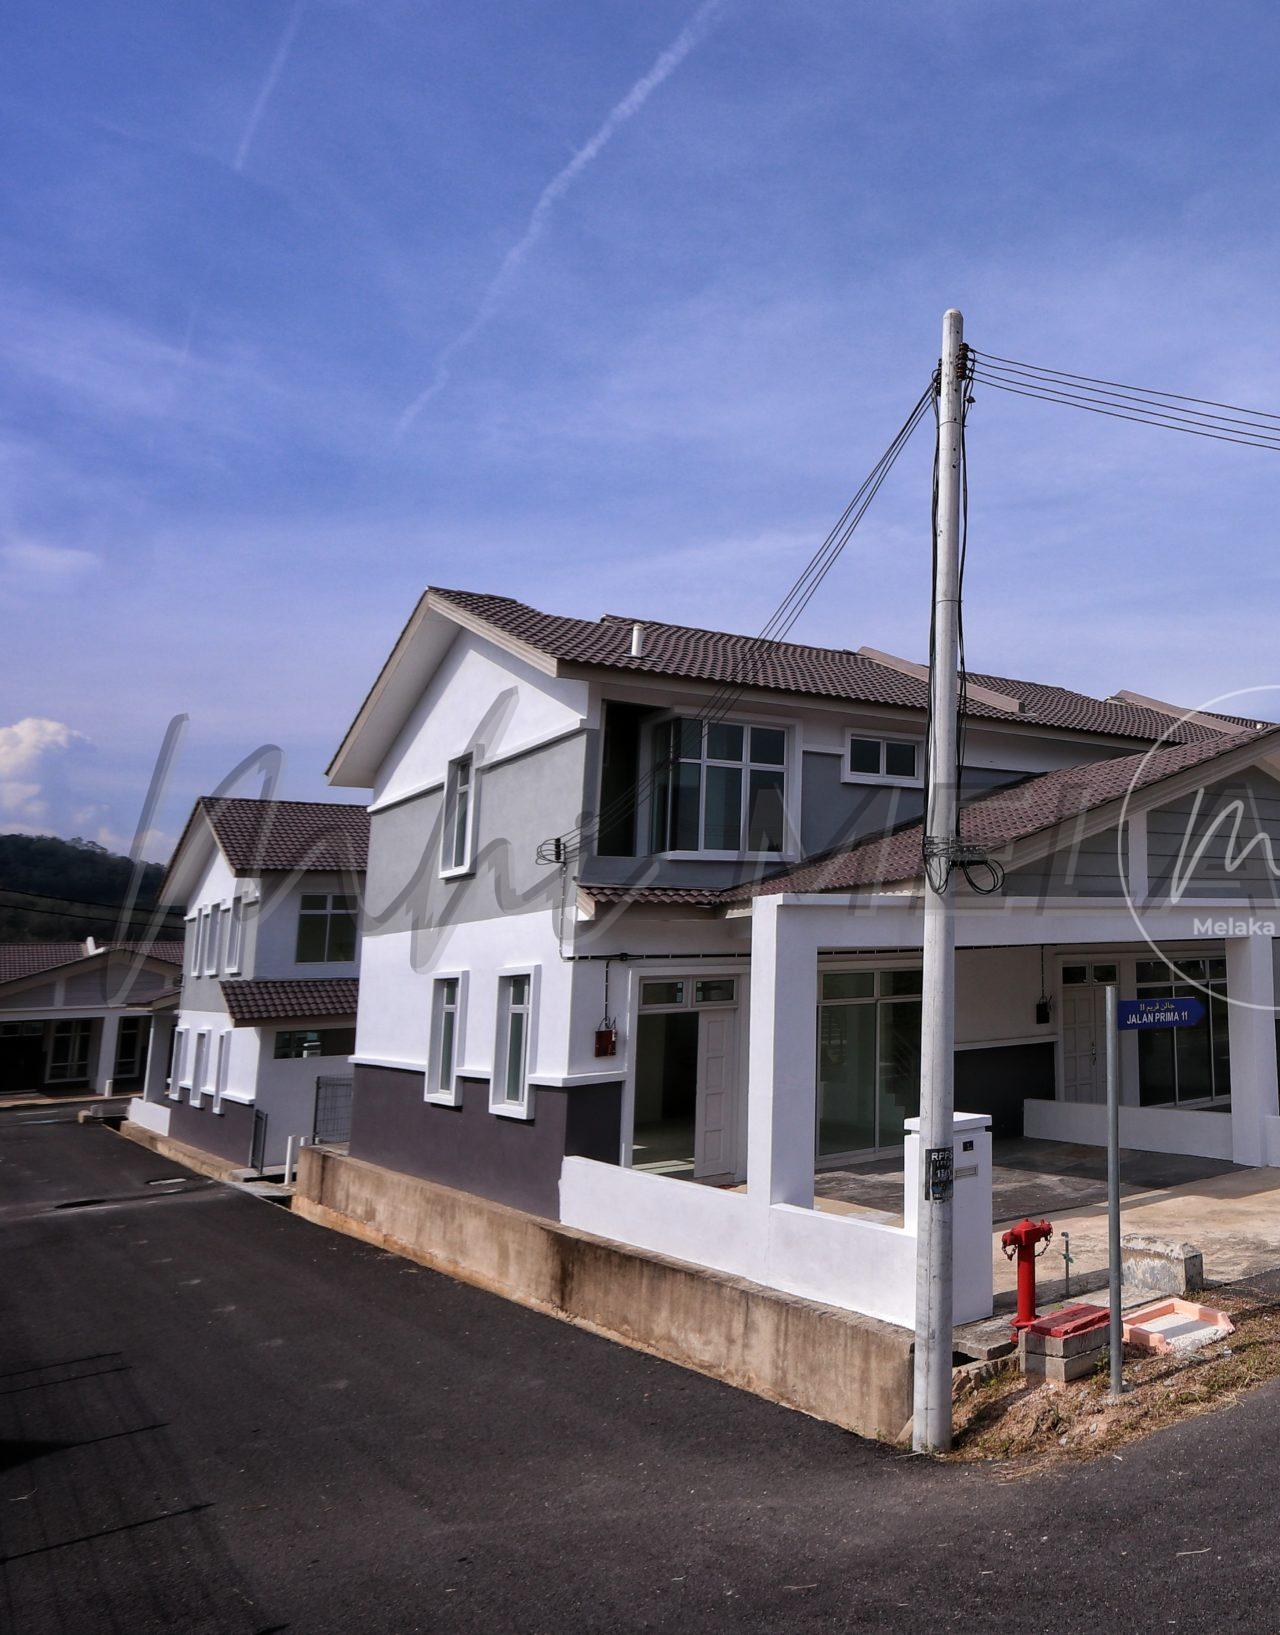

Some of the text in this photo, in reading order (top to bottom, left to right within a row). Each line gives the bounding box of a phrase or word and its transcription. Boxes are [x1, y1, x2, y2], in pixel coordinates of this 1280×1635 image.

[1127, 1011, 1188, 1024] JALAN PRIMA 11
